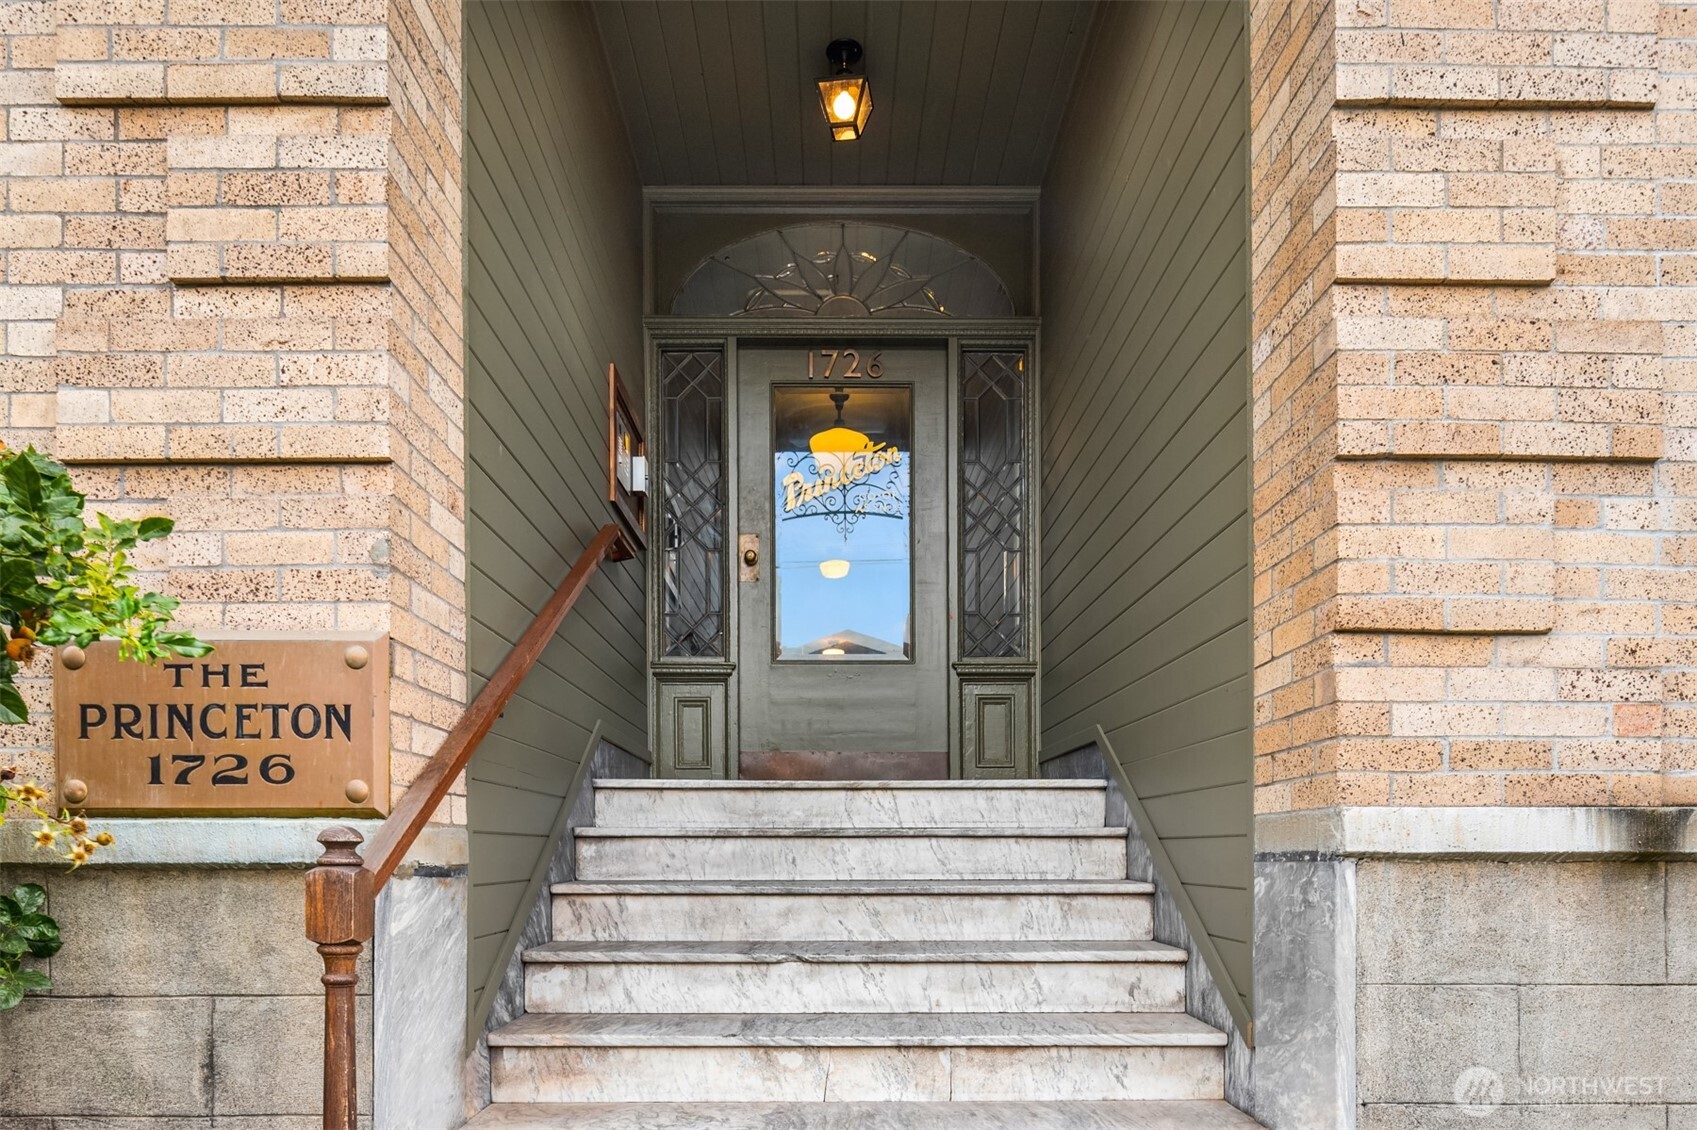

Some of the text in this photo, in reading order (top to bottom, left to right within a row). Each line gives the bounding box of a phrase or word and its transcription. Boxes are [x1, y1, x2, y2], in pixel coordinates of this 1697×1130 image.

[807, 348, 884, 380] 1726
[163, 662, 269, 689] THE
[78, 703, 353, 742] PRINCETON
[147, 753, 296, 787] 1726
